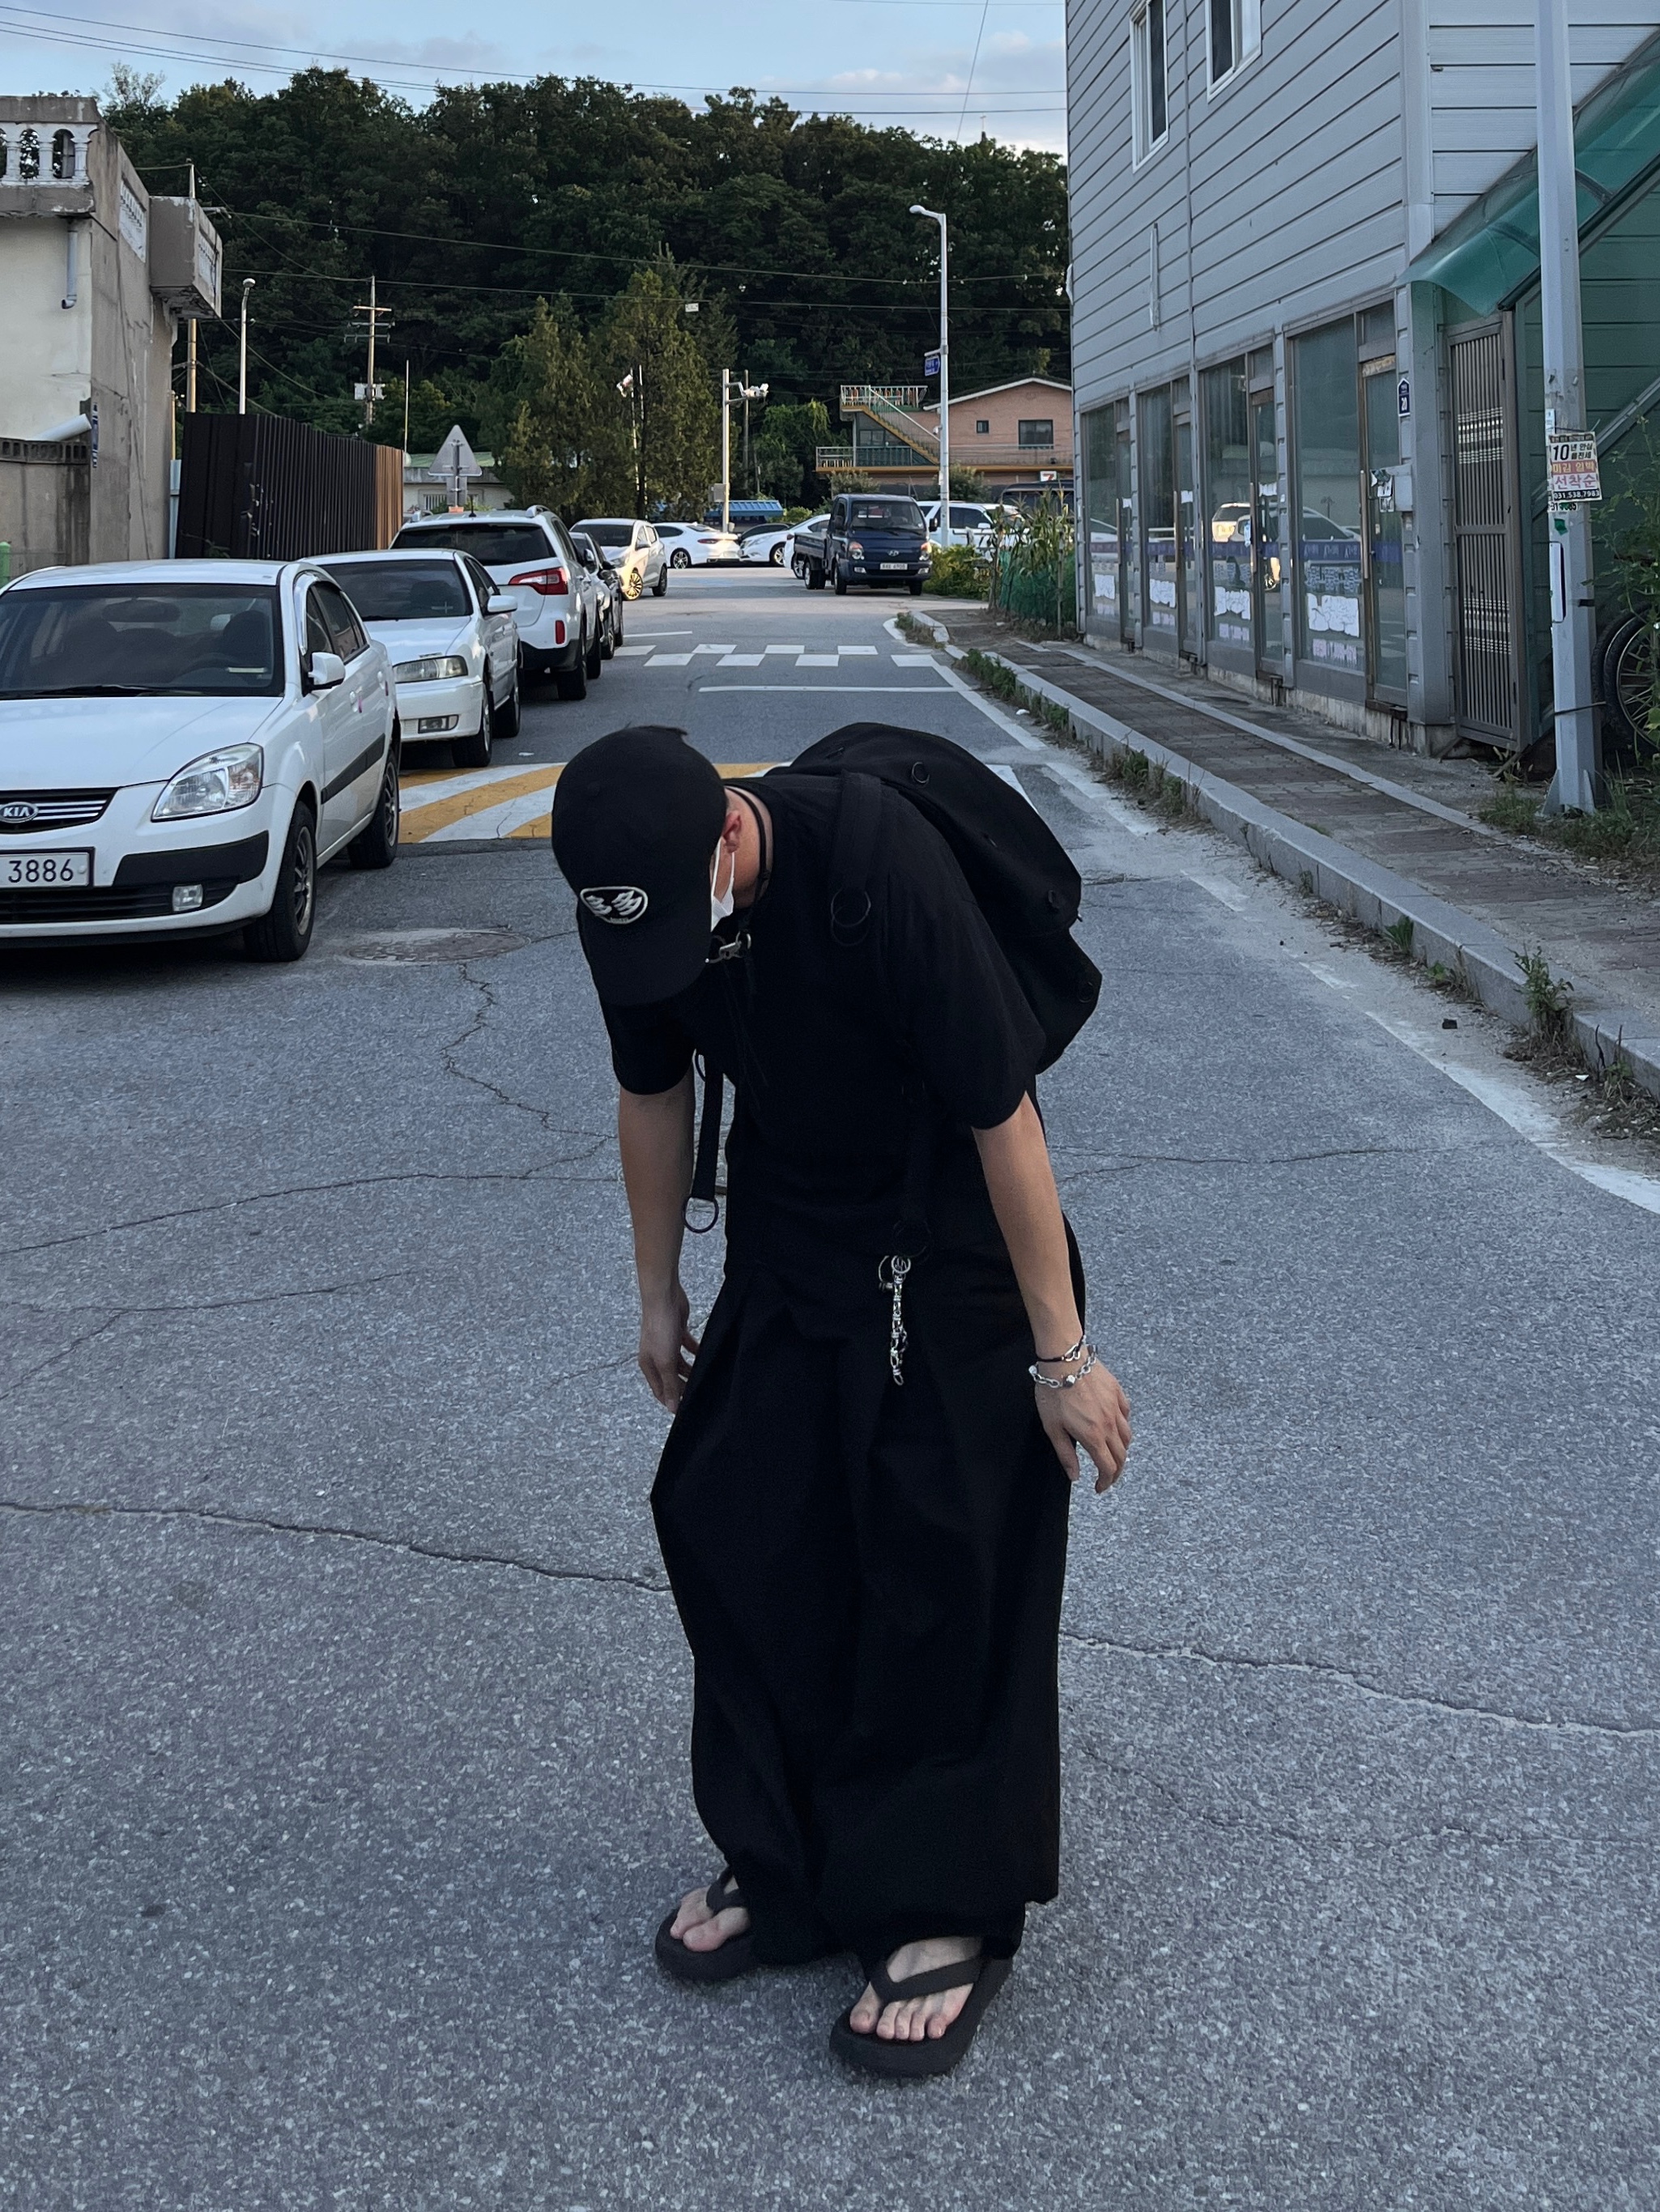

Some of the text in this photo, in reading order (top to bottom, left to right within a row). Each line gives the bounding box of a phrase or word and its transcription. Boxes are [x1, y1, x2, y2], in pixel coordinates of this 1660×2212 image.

[1401, 397, 1407, 411] 20
[1553, 445, 1569, 461] 10
[1555, 474, 1596, 489] 선착순
[3, 807, 31, 818] KIA
[8, 858, 74, 883] 3886
